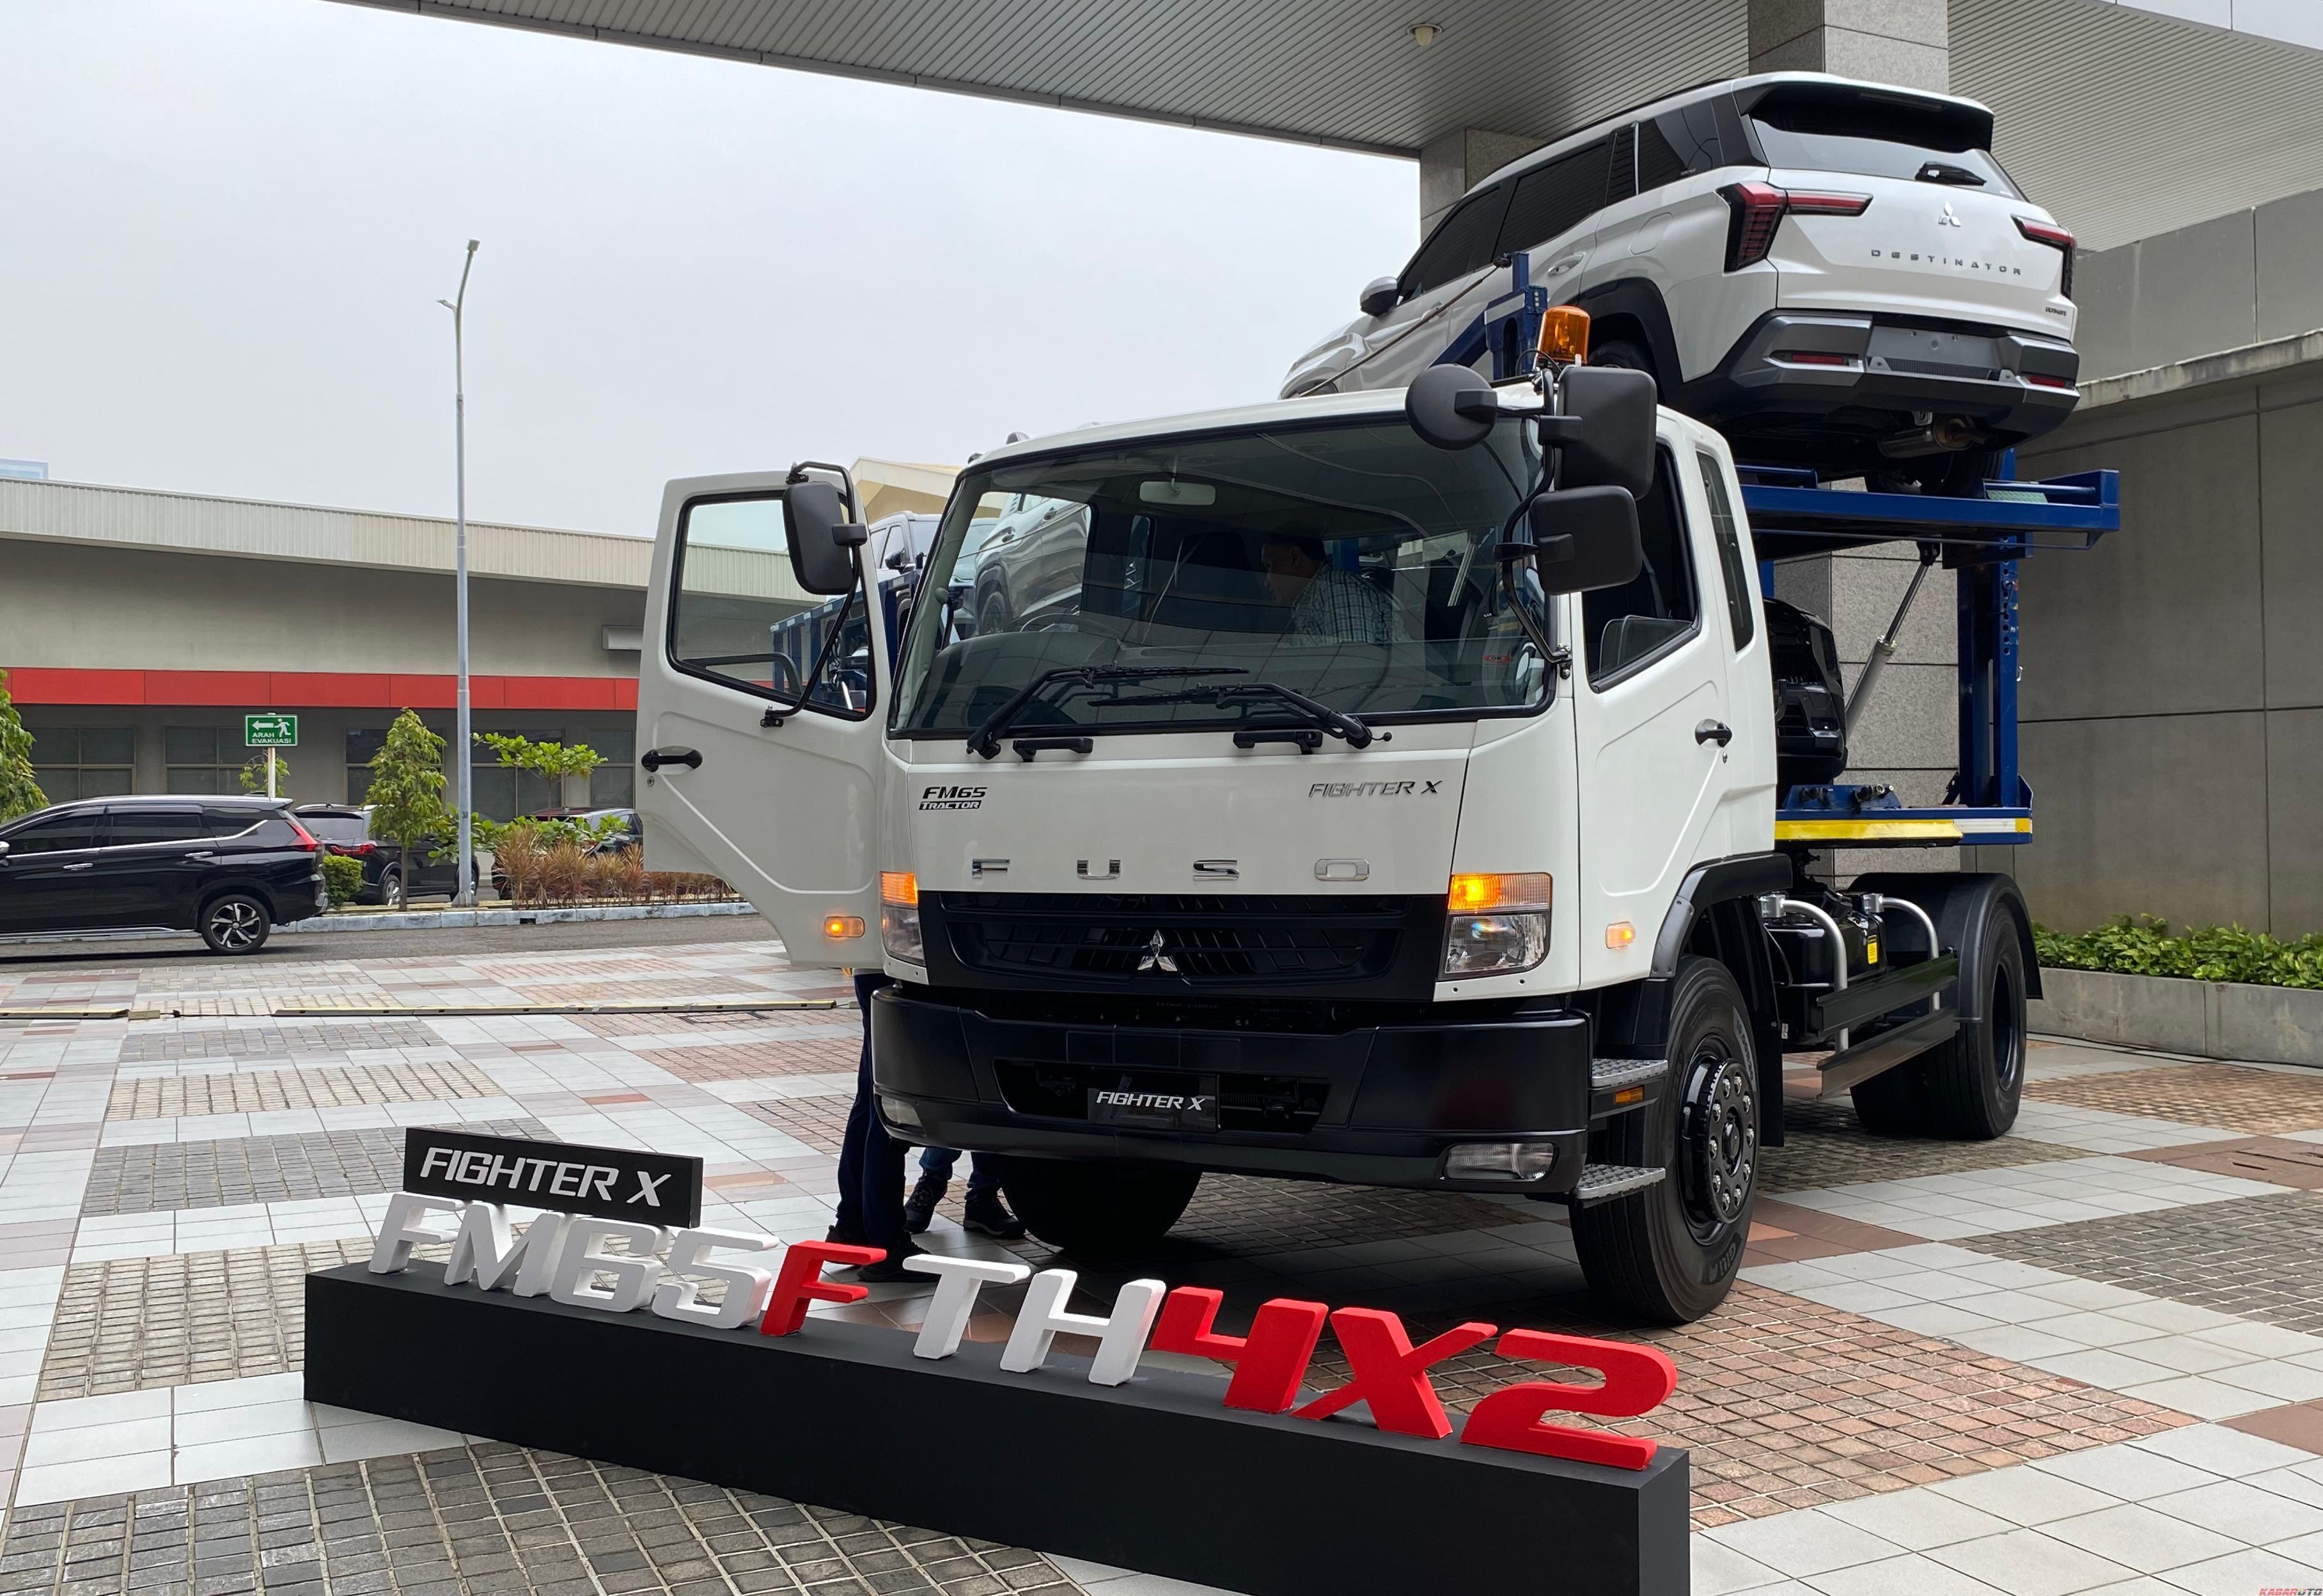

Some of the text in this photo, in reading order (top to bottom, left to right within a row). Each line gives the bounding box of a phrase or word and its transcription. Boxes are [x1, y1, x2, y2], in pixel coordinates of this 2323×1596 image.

[1871, 249, 2021, 276] DESTINATOR
[922, 786, 988, 799] FM65
[1308, 780, 1443, 797] FIGHTER X
[921, 801, 980, 810] TRACTOR
[972, 858, 1370, 882] FUSO
[1096, 1091, 1206, 1111] FIGHTER X
[419, 1146, 671, 1207] FIGHTER X
